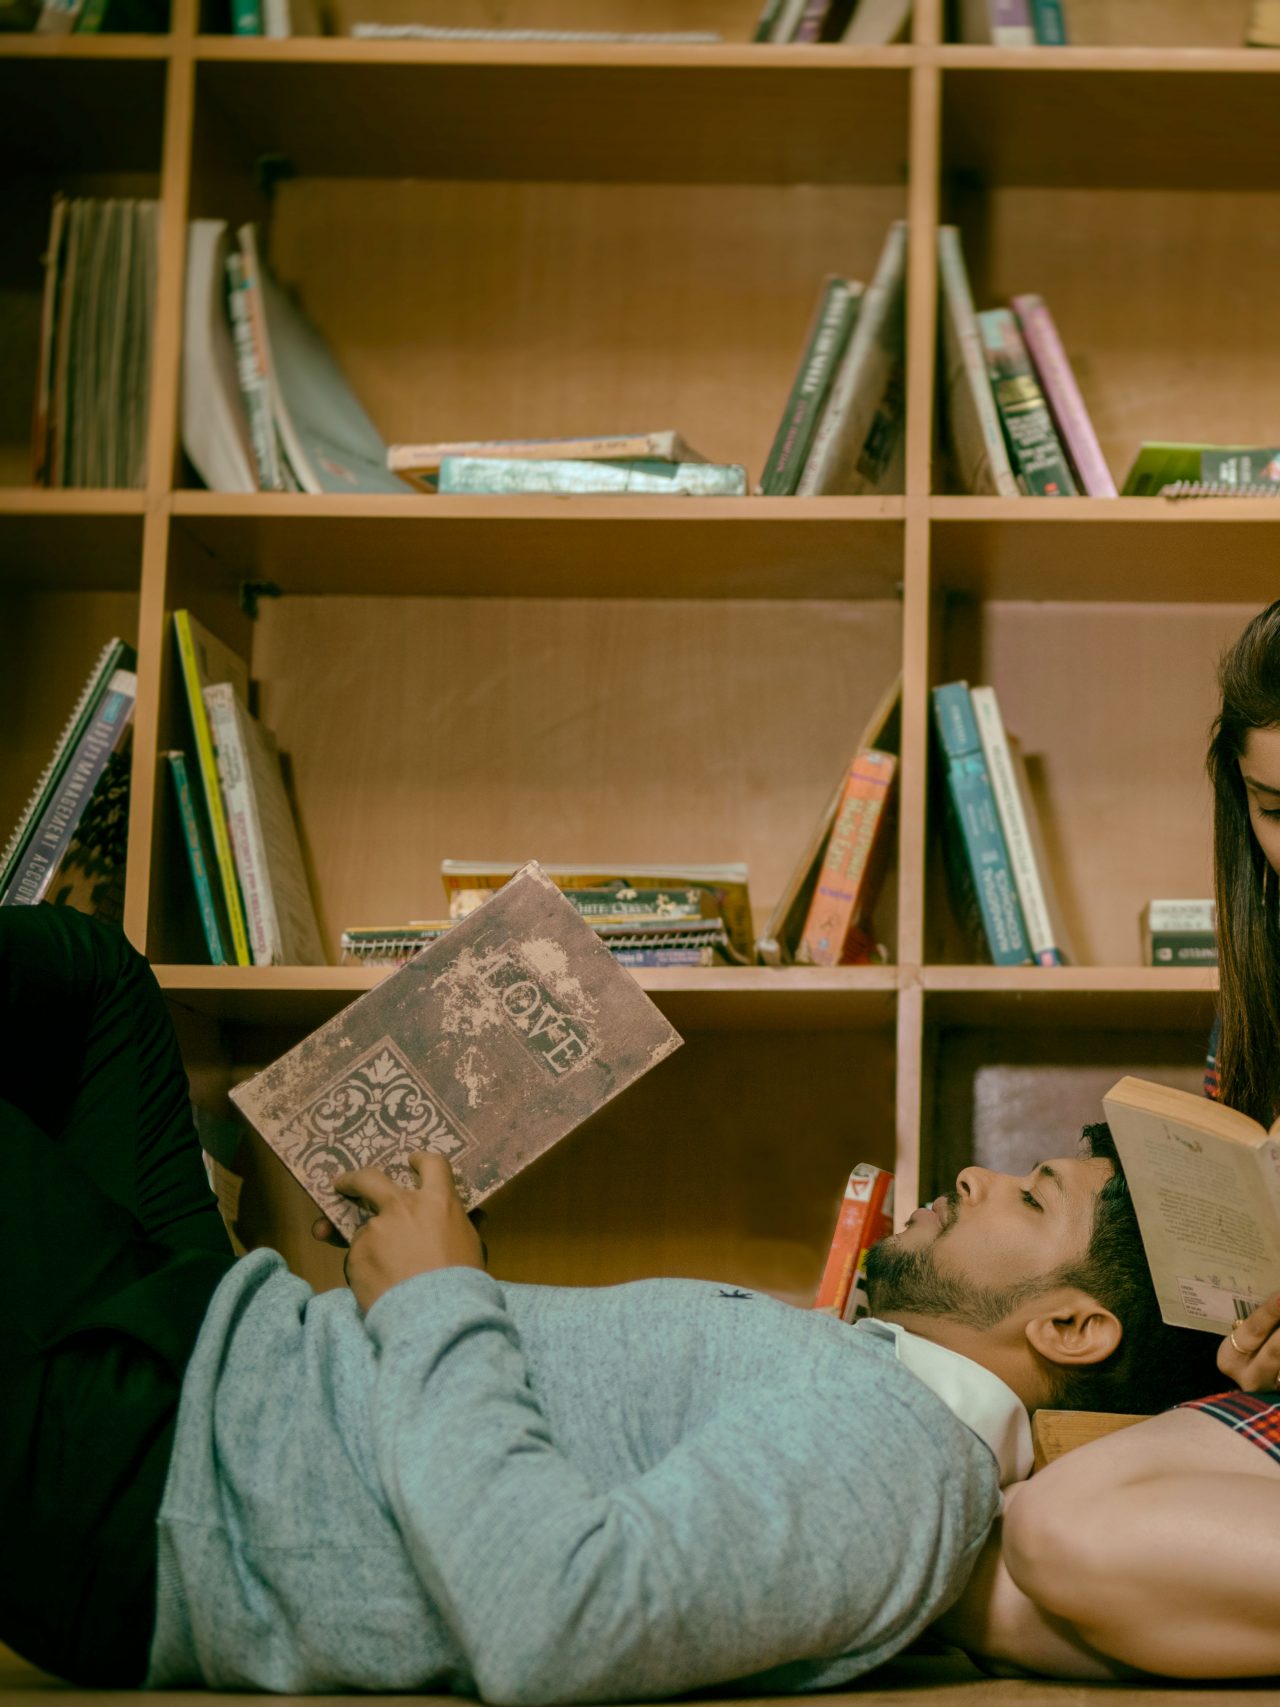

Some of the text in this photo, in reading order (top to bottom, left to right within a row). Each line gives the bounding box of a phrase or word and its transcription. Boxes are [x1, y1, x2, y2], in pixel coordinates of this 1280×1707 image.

[40, 757, 93, 851] MANAGEMENT
[577, 903, 609, 915] HITE
[475, 953, 589, 1074] LOVE
